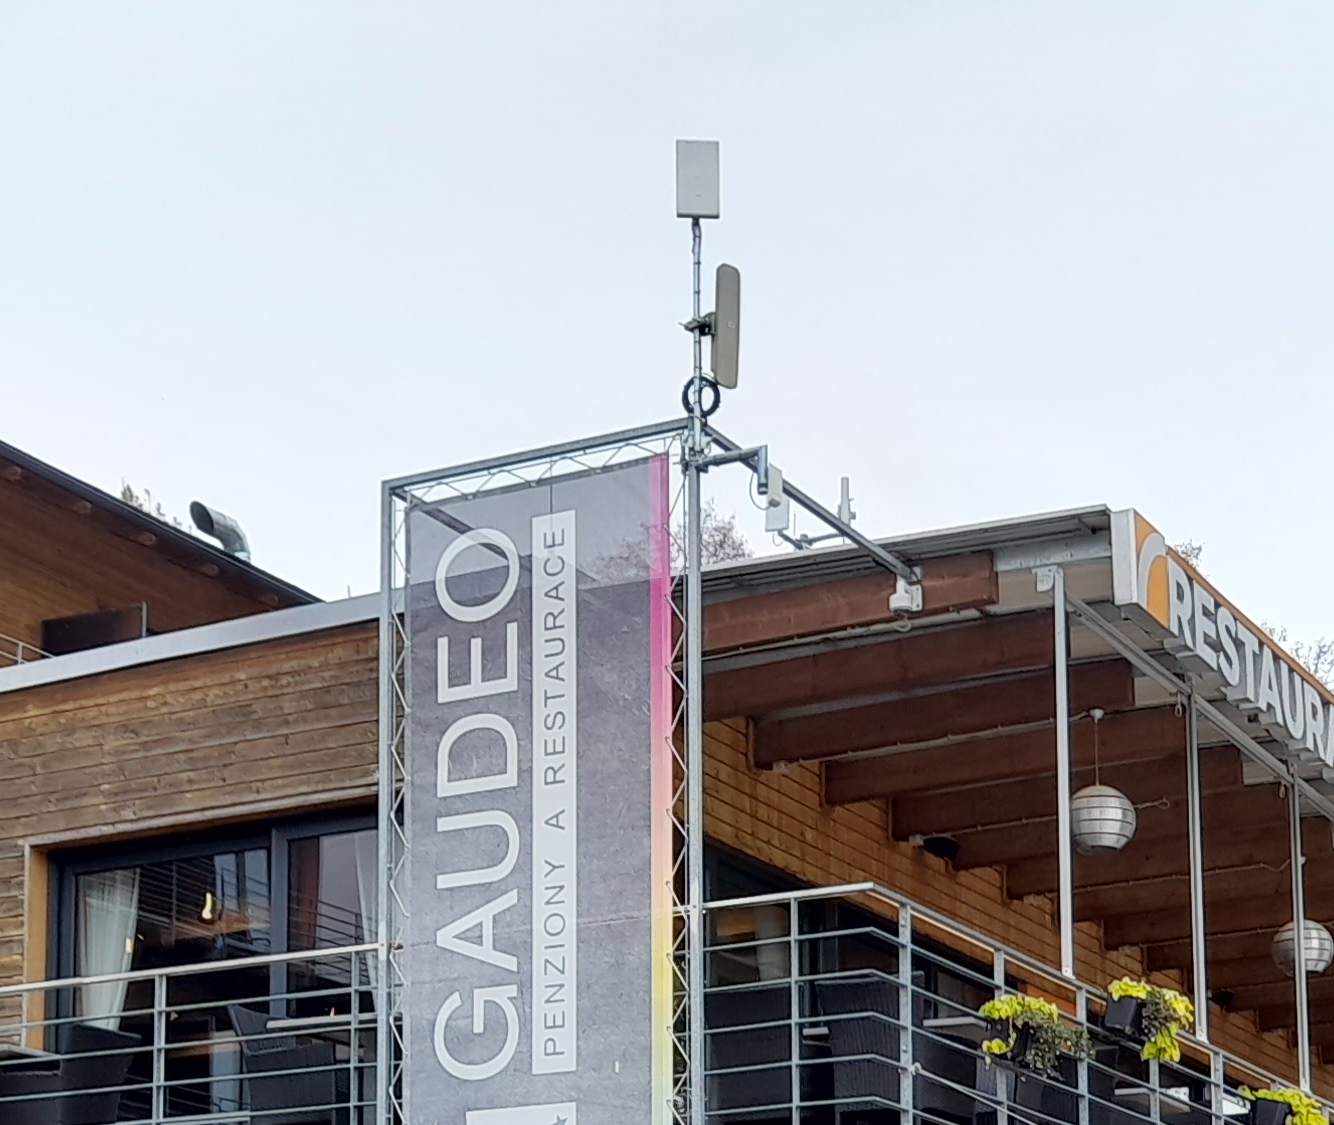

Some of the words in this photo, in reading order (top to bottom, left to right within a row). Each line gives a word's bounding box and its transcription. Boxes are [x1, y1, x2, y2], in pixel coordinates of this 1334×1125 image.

[542, 528, 567, 786] RESTAURACE
[433, 526, 521, 1082] GAUDEO
[546, 809, 566, 830] A
[543, 860, 568, 1058] PENZIONY
